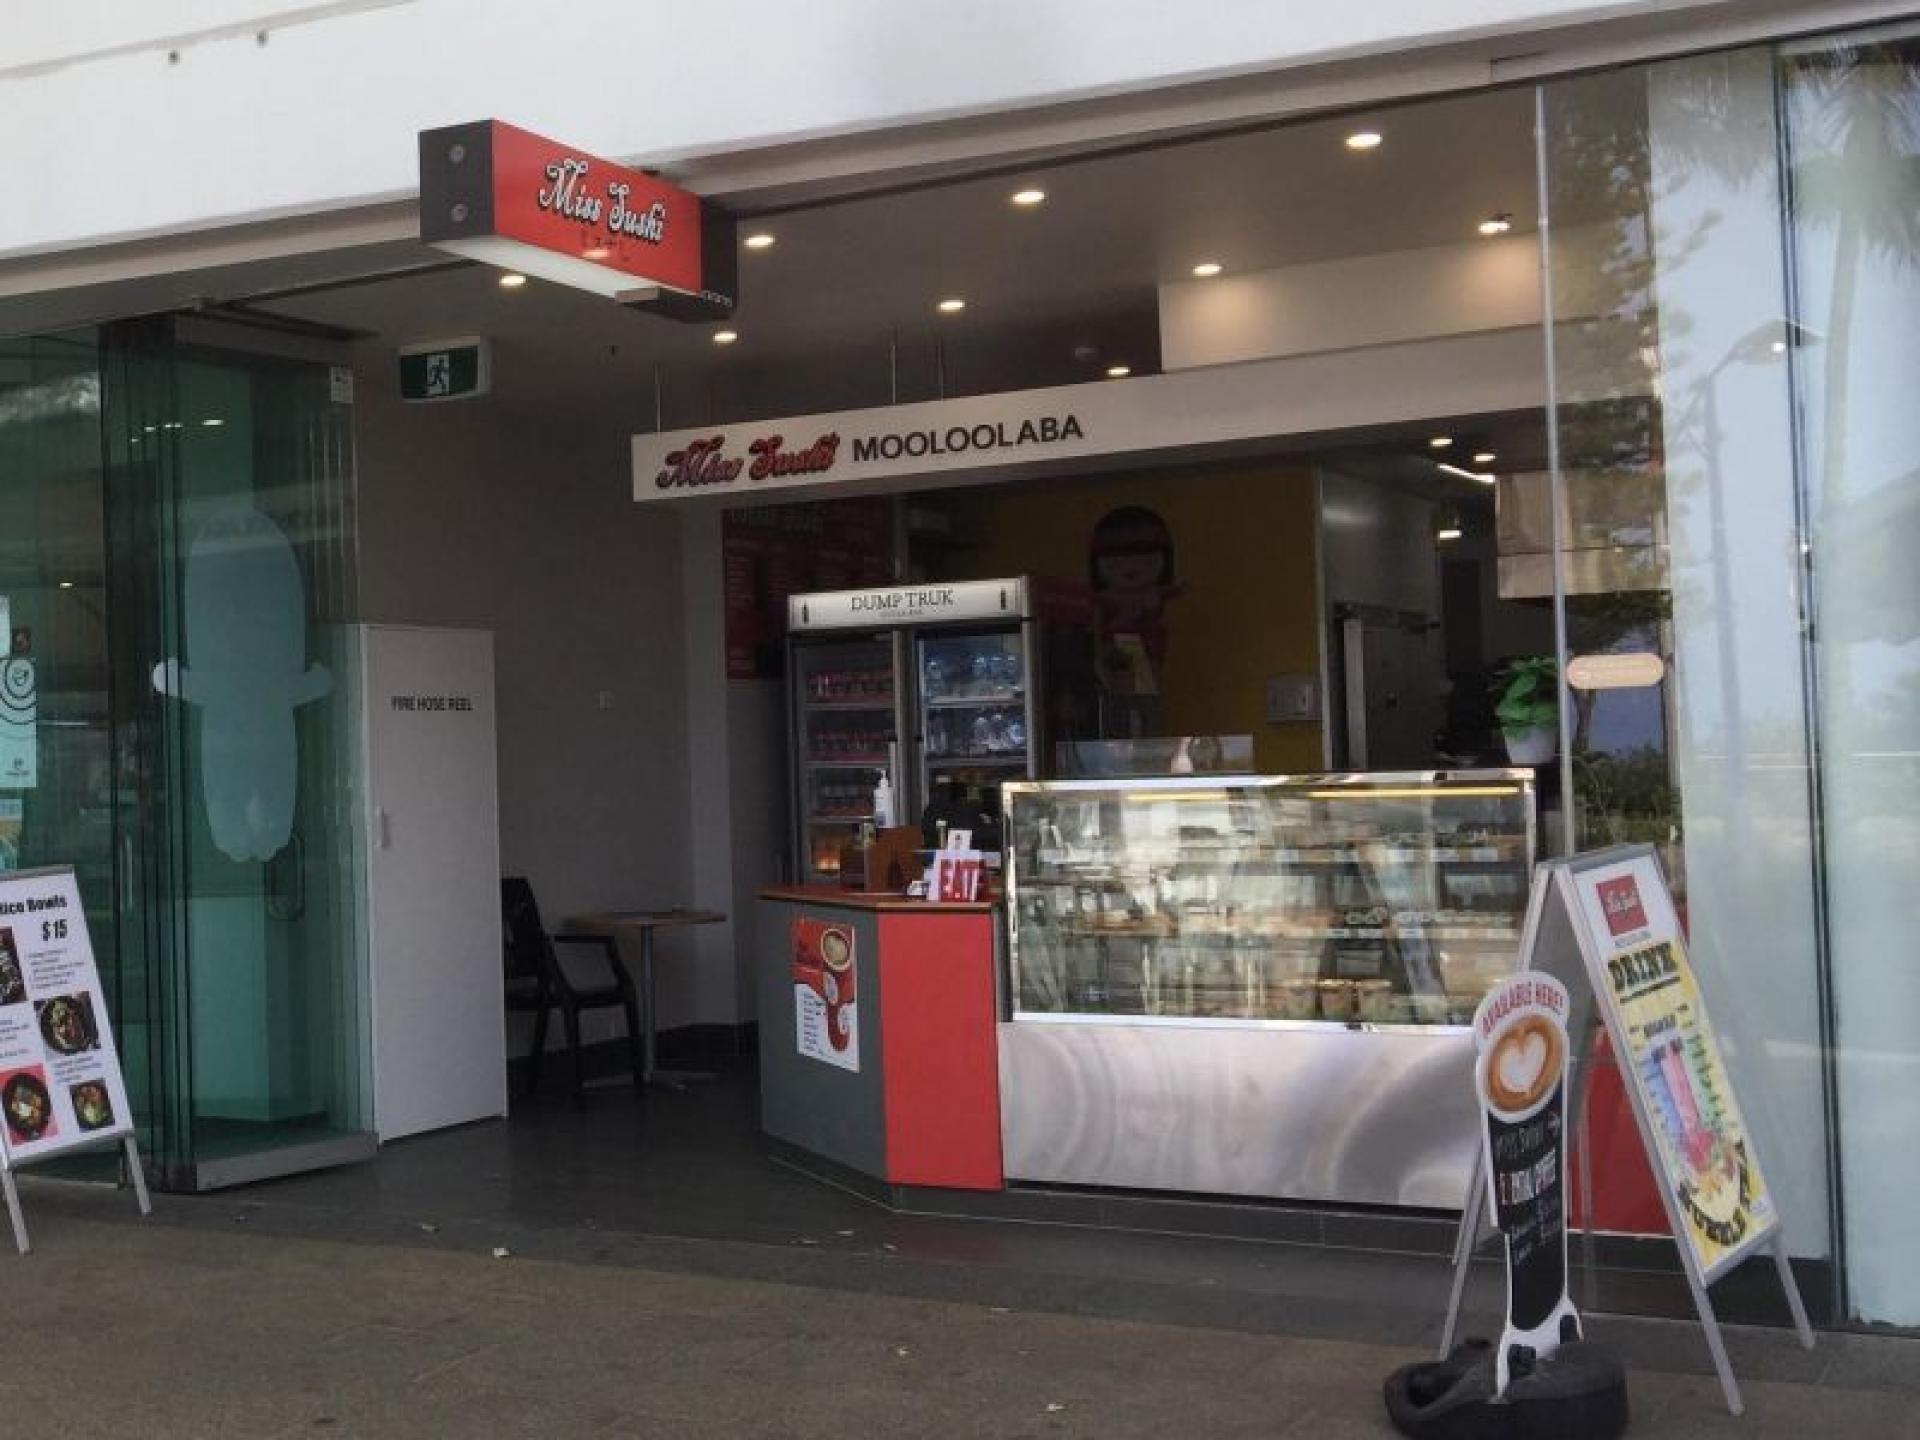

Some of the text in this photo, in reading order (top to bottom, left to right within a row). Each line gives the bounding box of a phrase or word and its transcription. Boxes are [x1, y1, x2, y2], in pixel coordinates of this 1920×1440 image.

[852, 414, 1084, 462] MOOLOOLABA
[851, 589, 955, 611] DUMP TRUK
[390, 695, 473, 711] FIRE HOSE REEL
